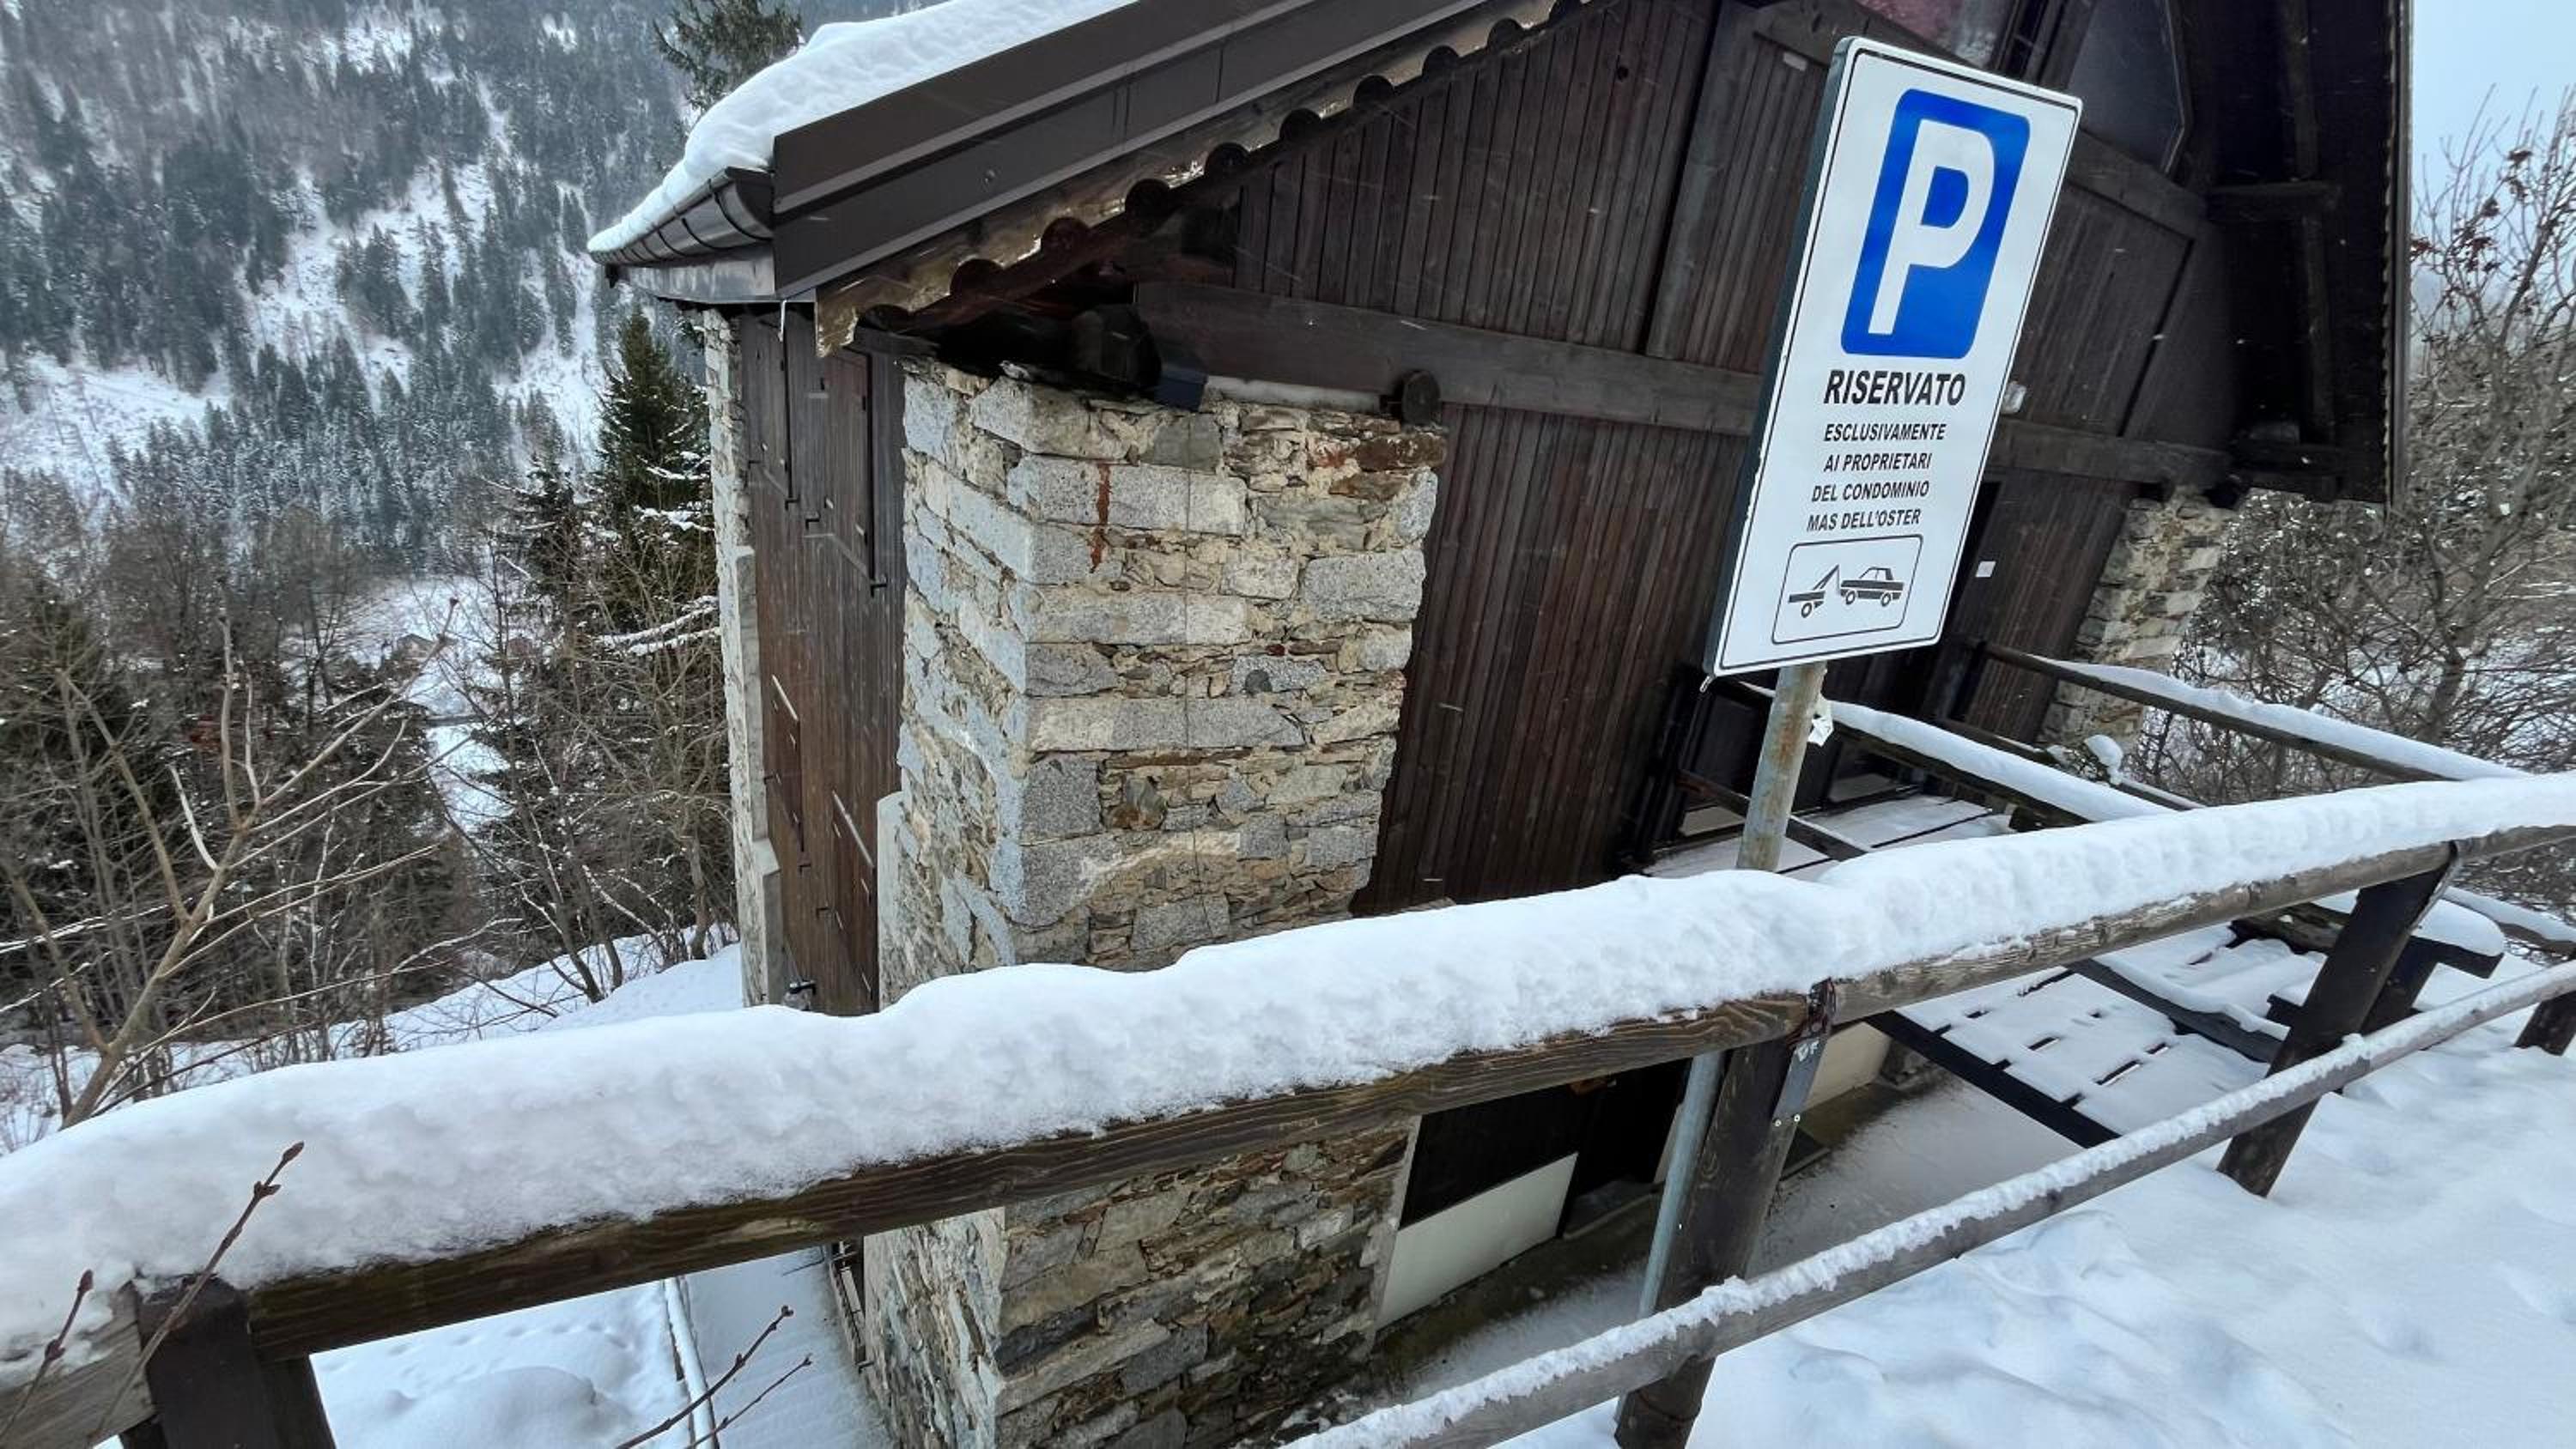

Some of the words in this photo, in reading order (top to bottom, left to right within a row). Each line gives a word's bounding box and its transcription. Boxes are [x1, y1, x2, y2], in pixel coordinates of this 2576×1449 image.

[1868, 118, 1995, 336] P
[1823, 369, 1966, 406] RISERVATO
[1823, 423, 1947, 442] ESCLUSIVAMENTE
[1823, 454, 1840, 472] AI
[1842, 452, 1933, 471] PROPRIETARI
[1811, 484, 1838, 502] DEL
[1842, 480, 1930, 501] CONDOMINIO
[1806, 512, 1838, 531] MAS
[1840, 508, 1922, 530] DELL'OSTER
